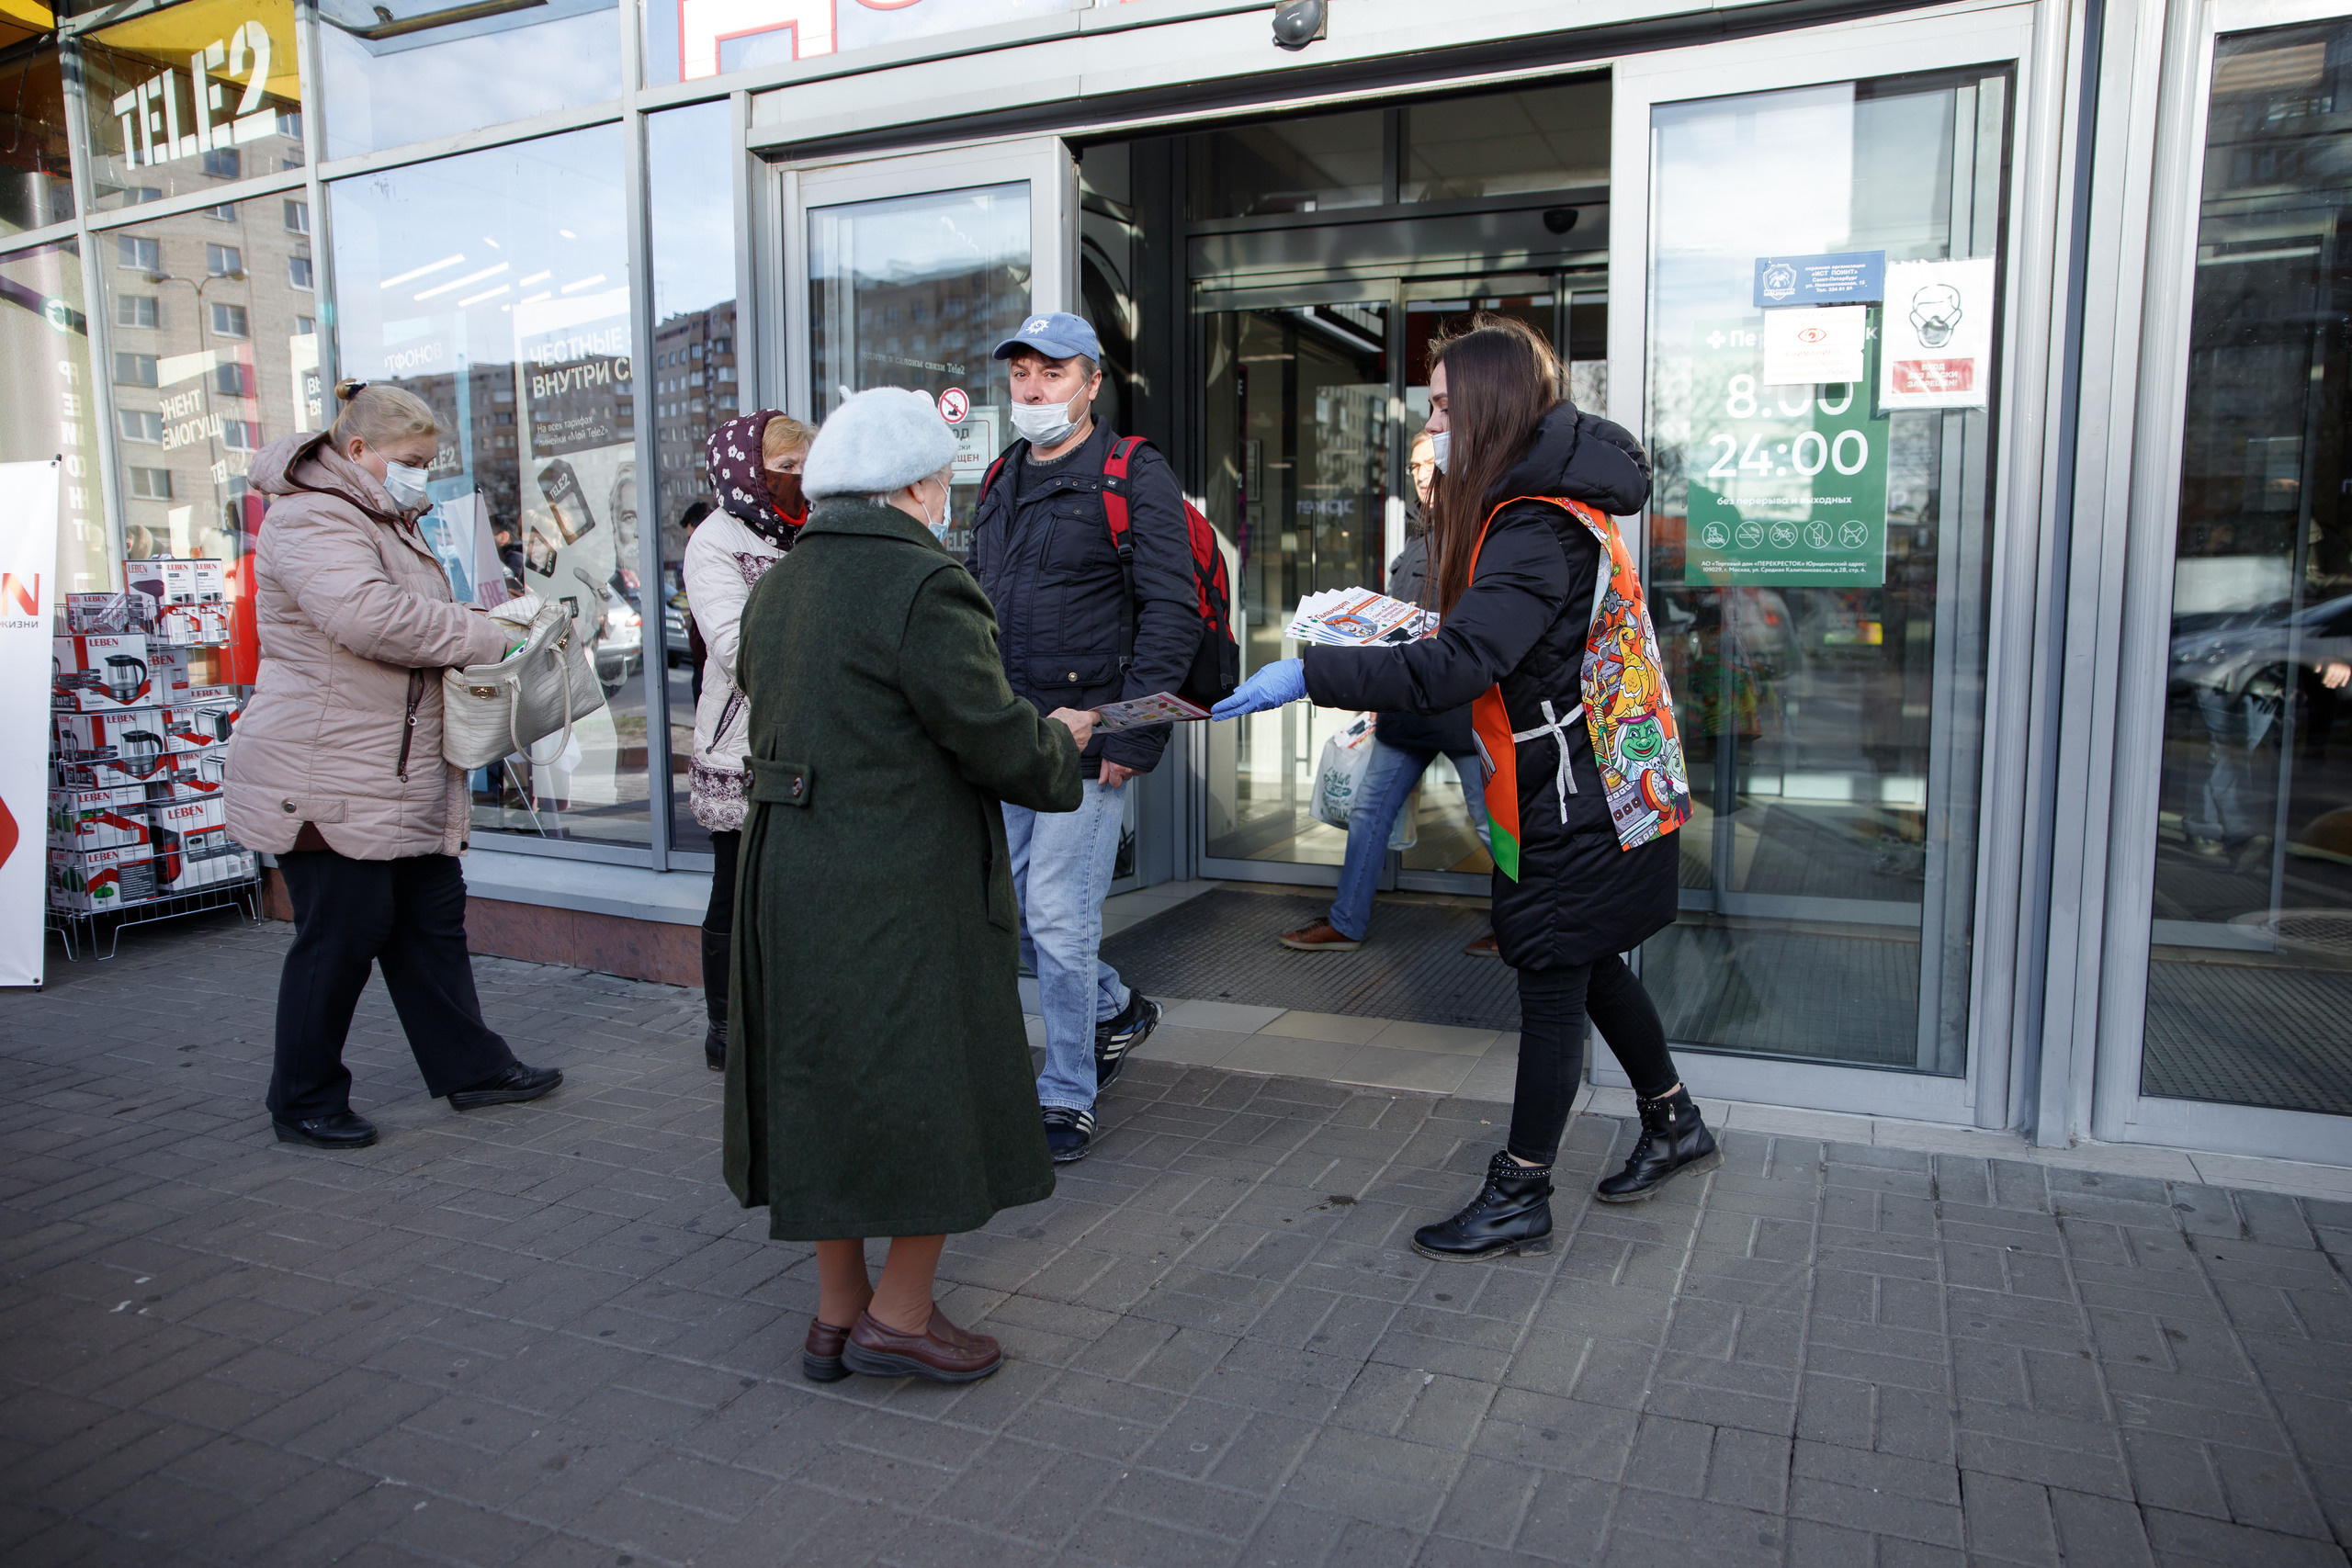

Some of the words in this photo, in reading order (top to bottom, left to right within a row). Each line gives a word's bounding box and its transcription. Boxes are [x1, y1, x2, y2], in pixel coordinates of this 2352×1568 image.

[113, 20, 277, 171] TELE2
[529, 326, 624, 367] ЧЕСТНЫЕ
[947, 363, 966, 375] Tele2
[532, 360, 610, 400] ВНУТРИ
[537, 423, 547, 434] На
[548, 422, 562, 432] всех
[564, 415, 594, 430] тарифах
[1707, 428, 1869, 478] 24:00
[549, 471, 571, 501] TELE2
[1717, 496, 1735, 506] без
[1736, 497, 1789, 508] перерыва
[1800, 495, 1852, 505] выходных
[128, 564, 148, 574] LEBEN
[88, 637, 119, 647] LEBEN
[107, 714, 136, 724] LEBEN
[178, 752, 199, 761] LEBEN
[78, 791, 110, 803] LEBEN
[167, 804, 204, 820] LEBEN
[88, 850, 119, 863] LEBEN
